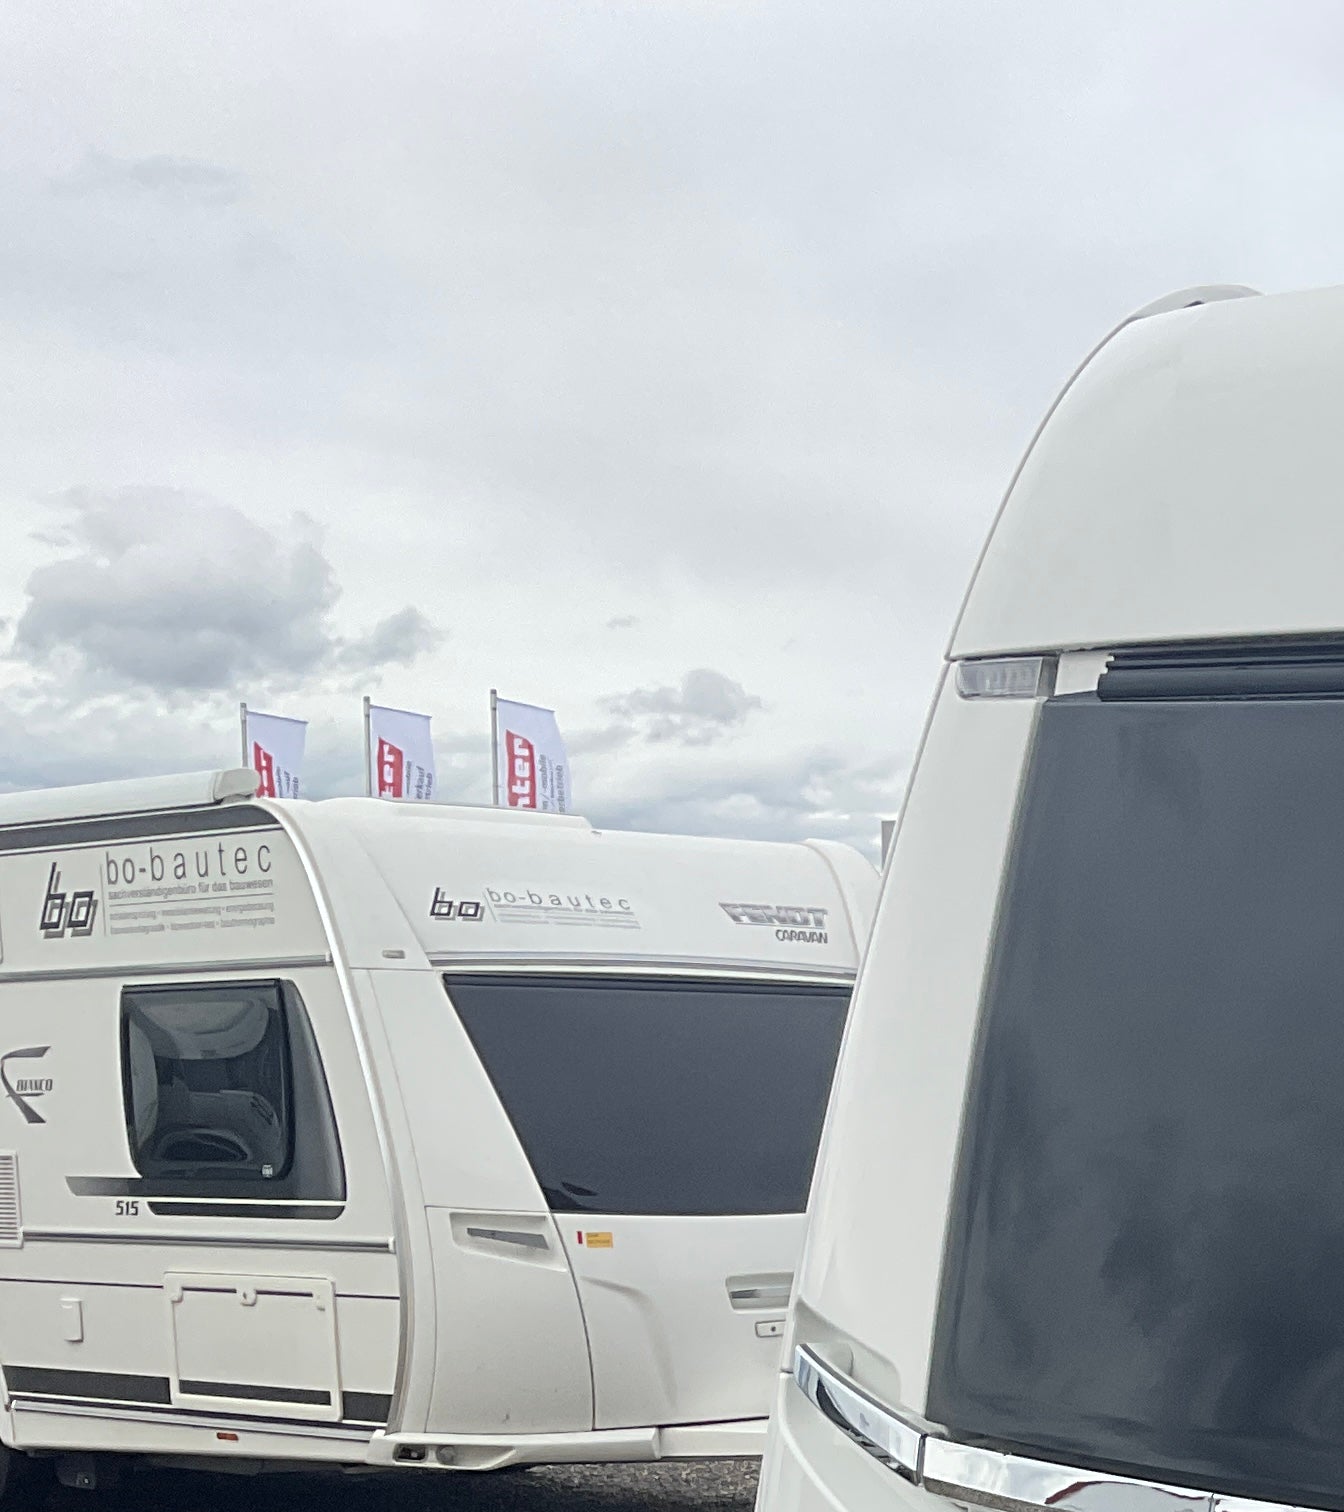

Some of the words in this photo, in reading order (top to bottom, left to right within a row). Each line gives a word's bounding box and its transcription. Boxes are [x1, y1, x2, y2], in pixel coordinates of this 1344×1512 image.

[105, 842, 271, 885] bo-bautec
[40, 862, 98, 939] bo
[430, 887, 485, 921] bo
[486, 888, 631, 911] bo-bautec
[719, 902, 828, 927] FENDT
[775, 929, 828, 944] CARAVAN
[115, 1201, 139, 1216] 515
